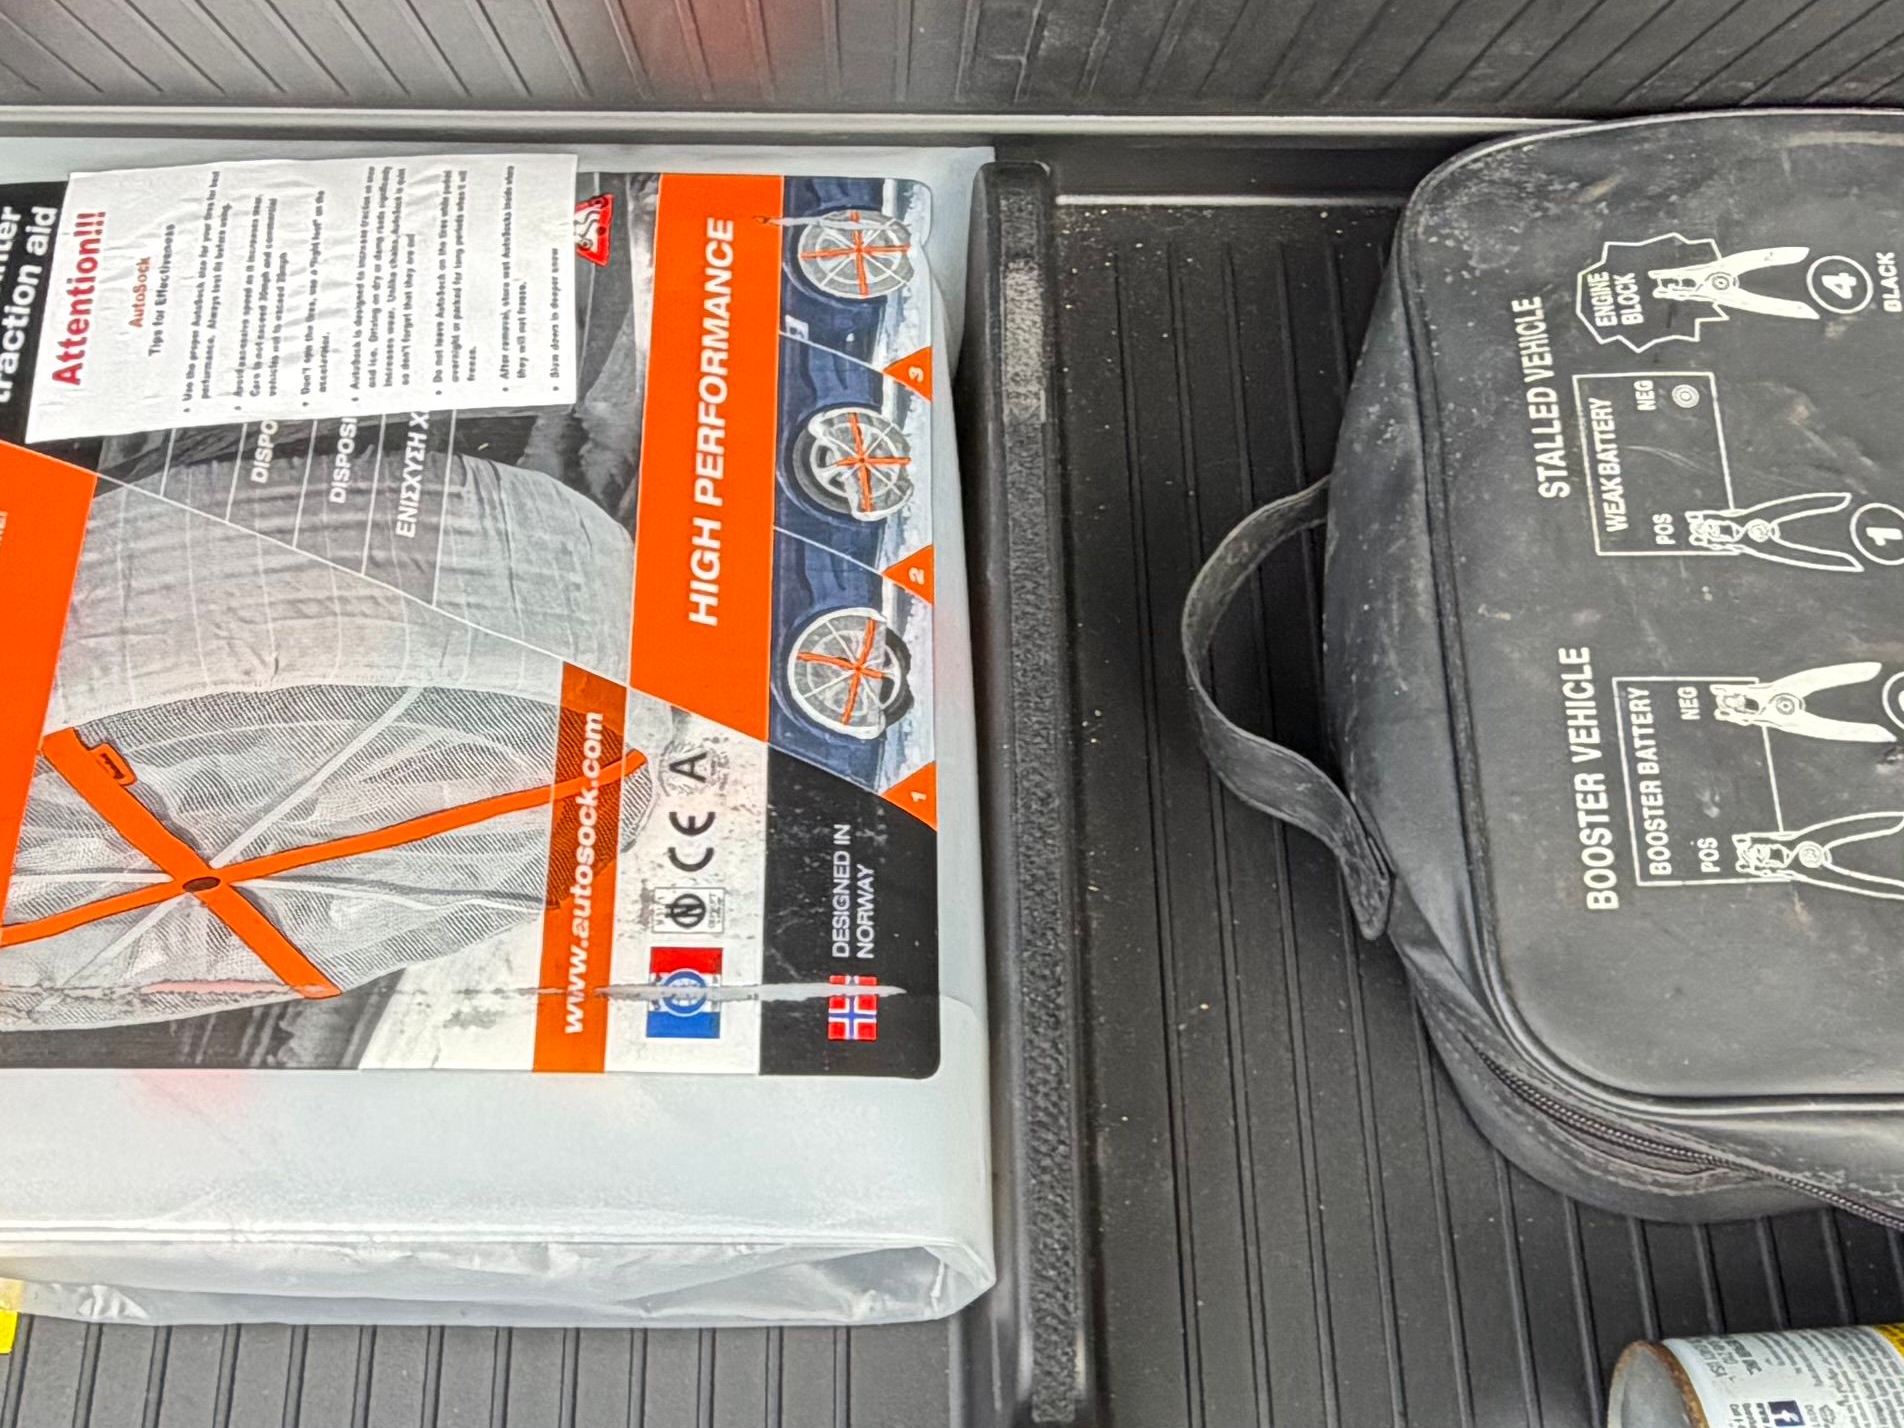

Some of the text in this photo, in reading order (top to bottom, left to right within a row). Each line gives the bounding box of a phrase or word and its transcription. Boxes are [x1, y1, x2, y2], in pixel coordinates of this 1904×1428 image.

[24, 205, 58, 256] aid
[50, 210, 106, 386] Attention!!!
[127, 255, 151, 328] AutoSock
[146, 222, 176, 357] Tips for Effectiveness
[1586, 271, 1618, 327] ENGINE
[1611, 271, 1644, 326] BLOCK
[1820, 271, 1857, 299] 4
[1874, 251, 1903, 313] BLACK
[907, 365, 924, 383] 3
[1510, 295, 1571, 498] STALLED VEHICLE
[1632, 378, 1657, 411] NEG
[688, 217, 734, 626] HIGH PERFORMANCE
[1587, 396, 1629, 532] WEAK BATTERY
[1651, 512, 1676, 545] POS
[1864, 525, 1903, 547] 1
[907, 566, 925, 585] 2
[1676, 685, 1701, 720] NEG
[910, 790, 927, 802] 1
[1557, 645, 1620, 910] BOOSTER VEHICLE
[1626, 686, 1673, 876] BOOSTER BATTERY
[564, 711, 603, 1034] www.autosock.com
[1695, 836, 1721, 873] POS
[830, 823, 851, 958] DESIGNED IN
[854, 862, 875, 959] NORWAY
